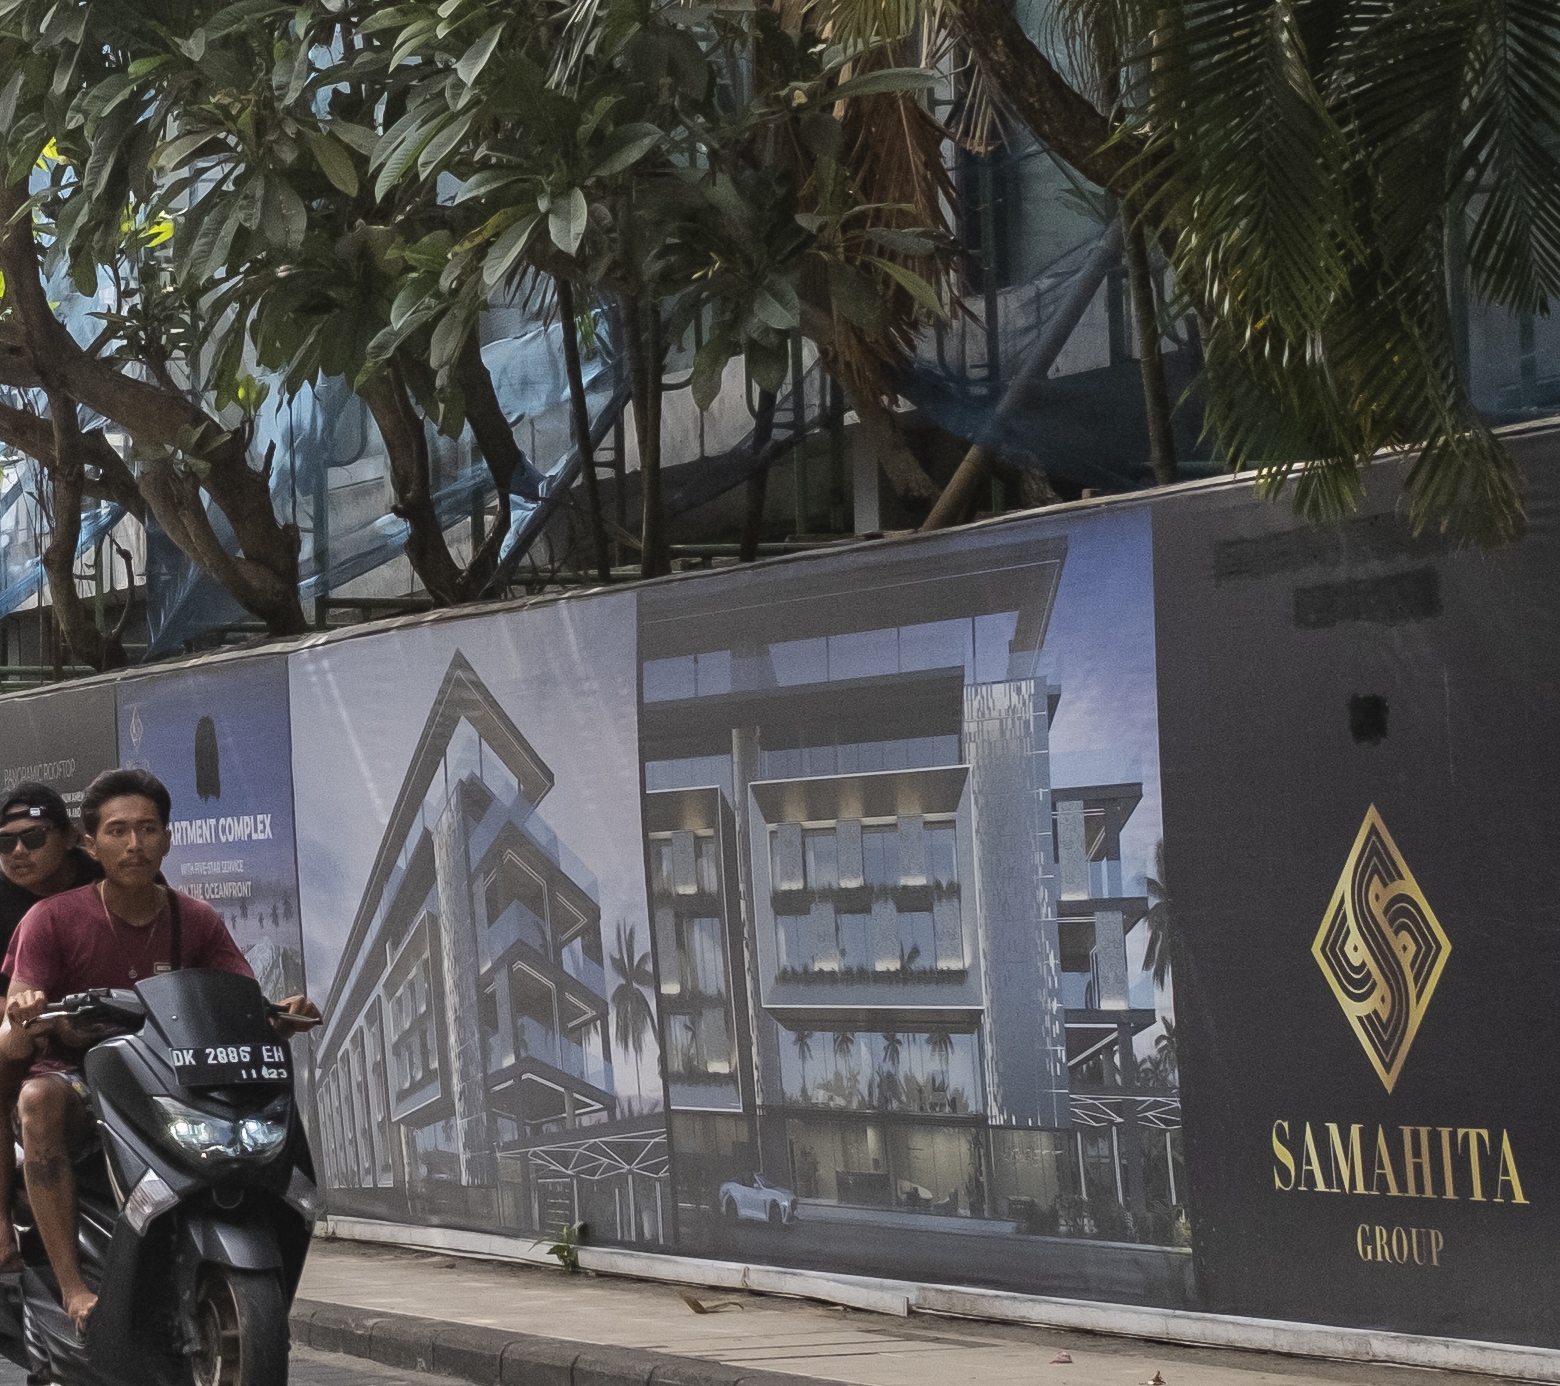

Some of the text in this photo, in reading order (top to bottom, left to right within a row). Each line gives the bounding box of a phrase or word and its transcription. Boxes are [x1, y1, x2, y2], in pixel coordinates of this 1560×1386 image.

[169, 814, 273, 846] ARTMENT COMPLEX
[204, 881, 253, 900] OCEANFRONT
[172, 1049, 196, 1066] DK
[1272, 1119, 1530, 1204] SAMAHITA
[1356, 1223, 1444, 1266] GROUP
